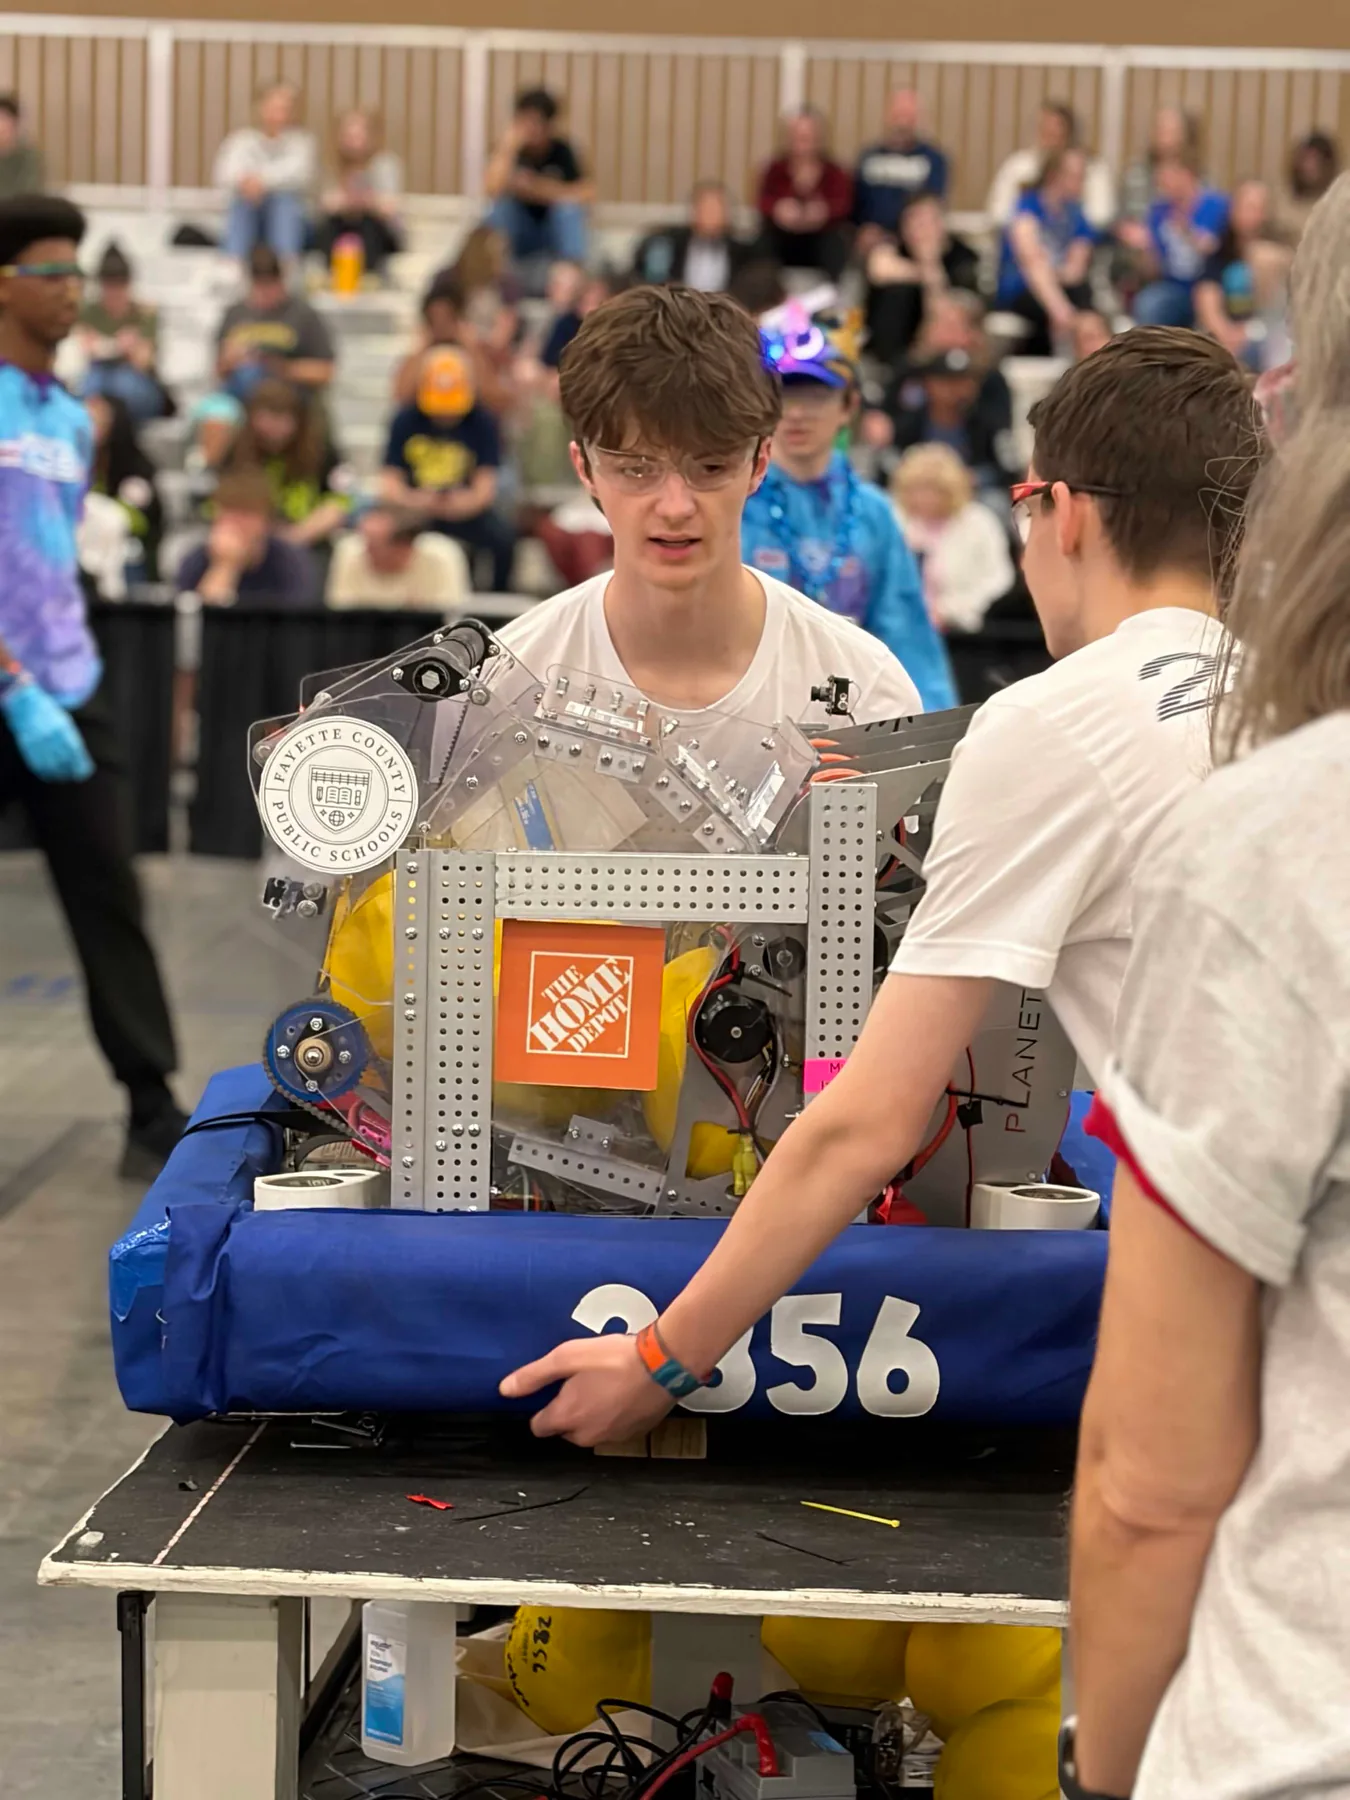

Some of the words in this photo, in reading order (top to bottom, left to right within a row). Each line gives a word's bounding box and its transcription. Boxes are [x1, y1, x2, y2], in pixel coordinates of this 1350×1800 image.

[274, 728, 342, 783] FAYETTE
[352, 731, 406, 794] COUNTY
[273, 800, 321, 858] PUBLIC
[329, 811, 403, 862] SCHOOLS
[529, 957, 631, 1052] HOME
[541, 964, 584, 1004] THE
[566, 994, 629, 1055] DEPOT
[1004, 989, 1043, 1133] PLANET
